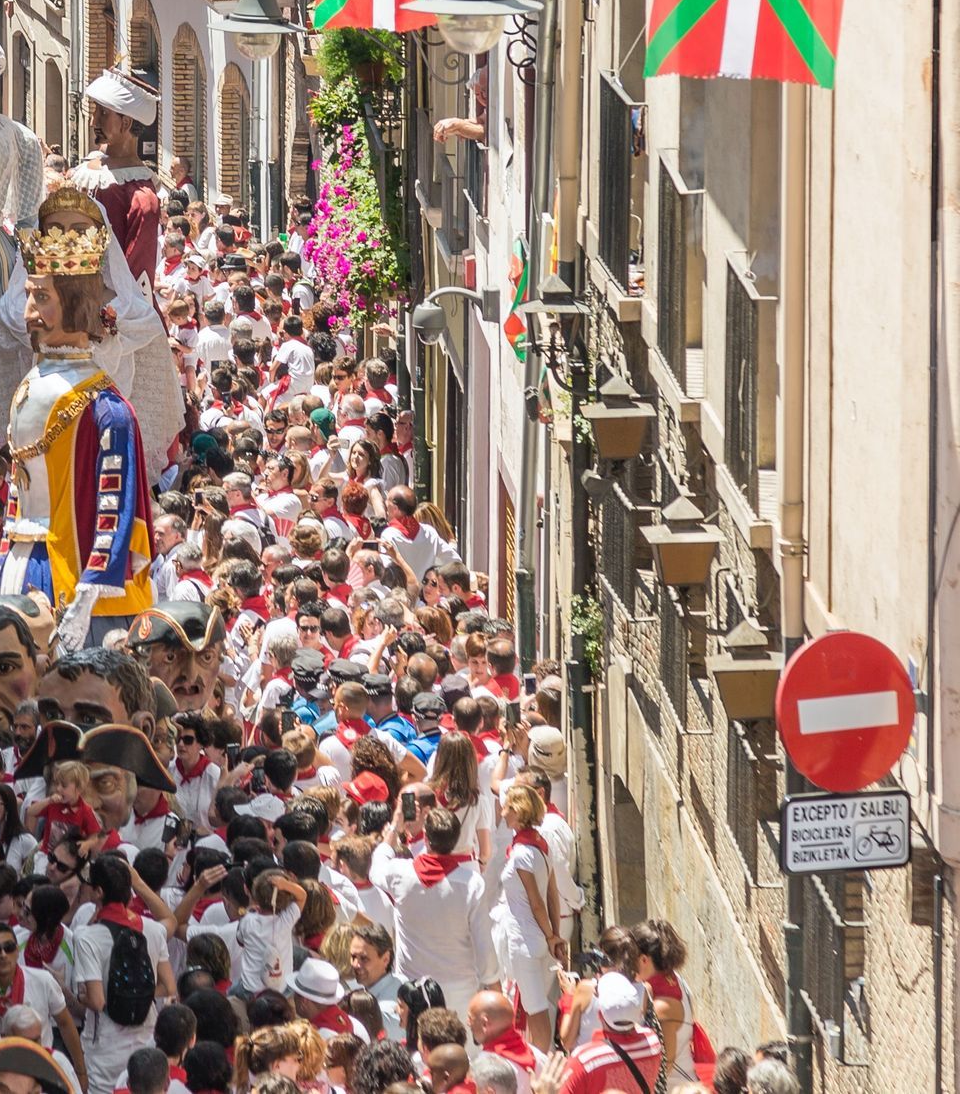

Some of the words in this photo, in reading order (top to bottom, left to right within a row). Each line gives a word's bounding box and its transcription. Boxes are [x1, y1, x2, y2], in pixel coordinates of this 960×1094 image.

[793, 804, 848, 822] EXCEPTO
[860, 800, 902, 818] SALBU:
[792, 826, 852, 842] BICICLETAS
[792, 848, 850, 864] BIZIKLETAK
